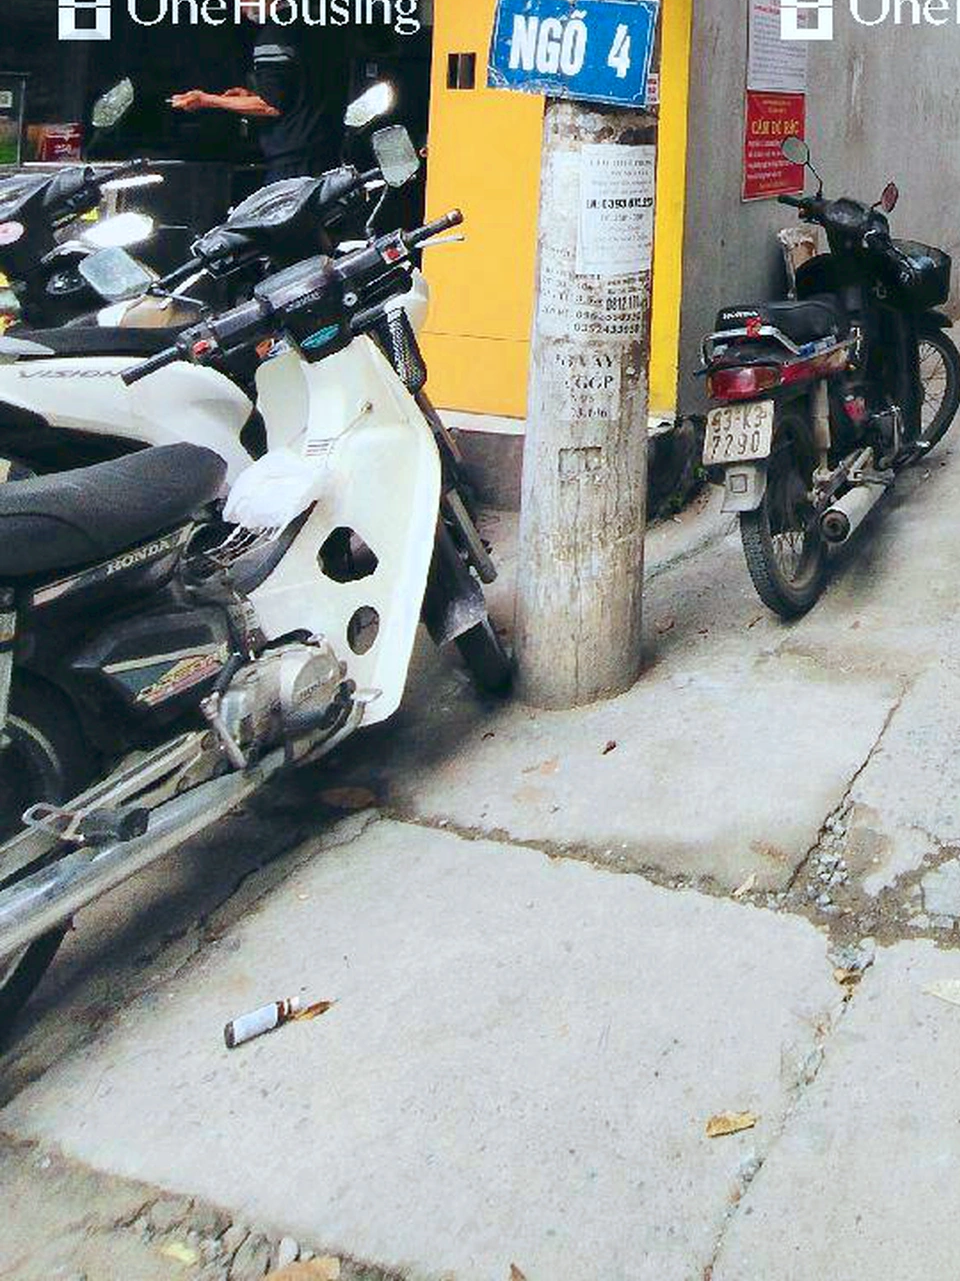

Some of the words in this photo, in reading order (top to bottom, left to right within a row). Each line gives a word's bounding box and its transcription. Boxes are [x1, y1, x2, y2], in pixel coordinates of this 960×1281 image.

[508, 8, 588, 77] NGÕ
[608, 24, 631, 78] 4
[19, 369, 122, 379] VISION
[106, 539, 170, 576] HONDA
